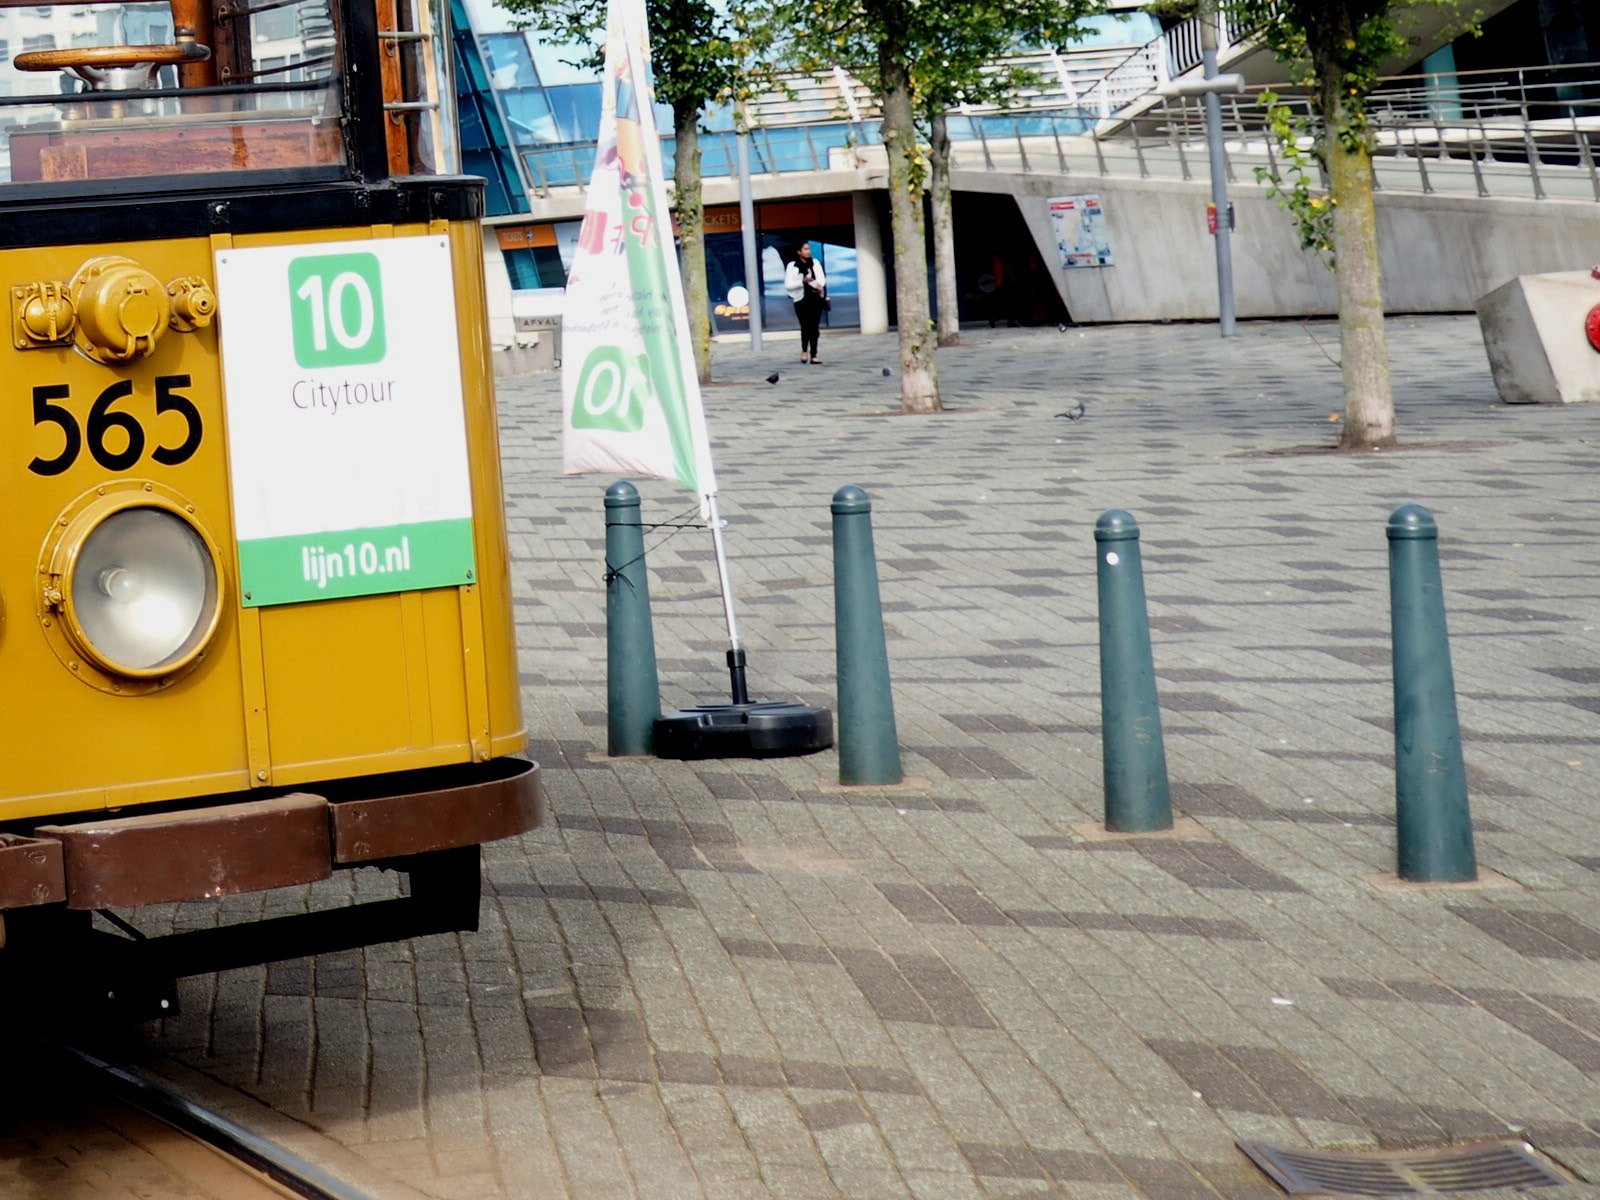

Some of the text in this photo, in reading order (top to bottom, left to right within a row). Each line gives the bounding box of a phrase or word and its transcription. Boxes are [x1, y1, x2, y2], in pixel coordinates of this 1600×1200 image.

[295, 270, 376, 353] 10
[523, 318, 558, 328] AFVAL
[290, 377, 396, 416] Citytour
[26, 373, 205, 478] 565
[300, 541, 411, 589] lijn10.nl
